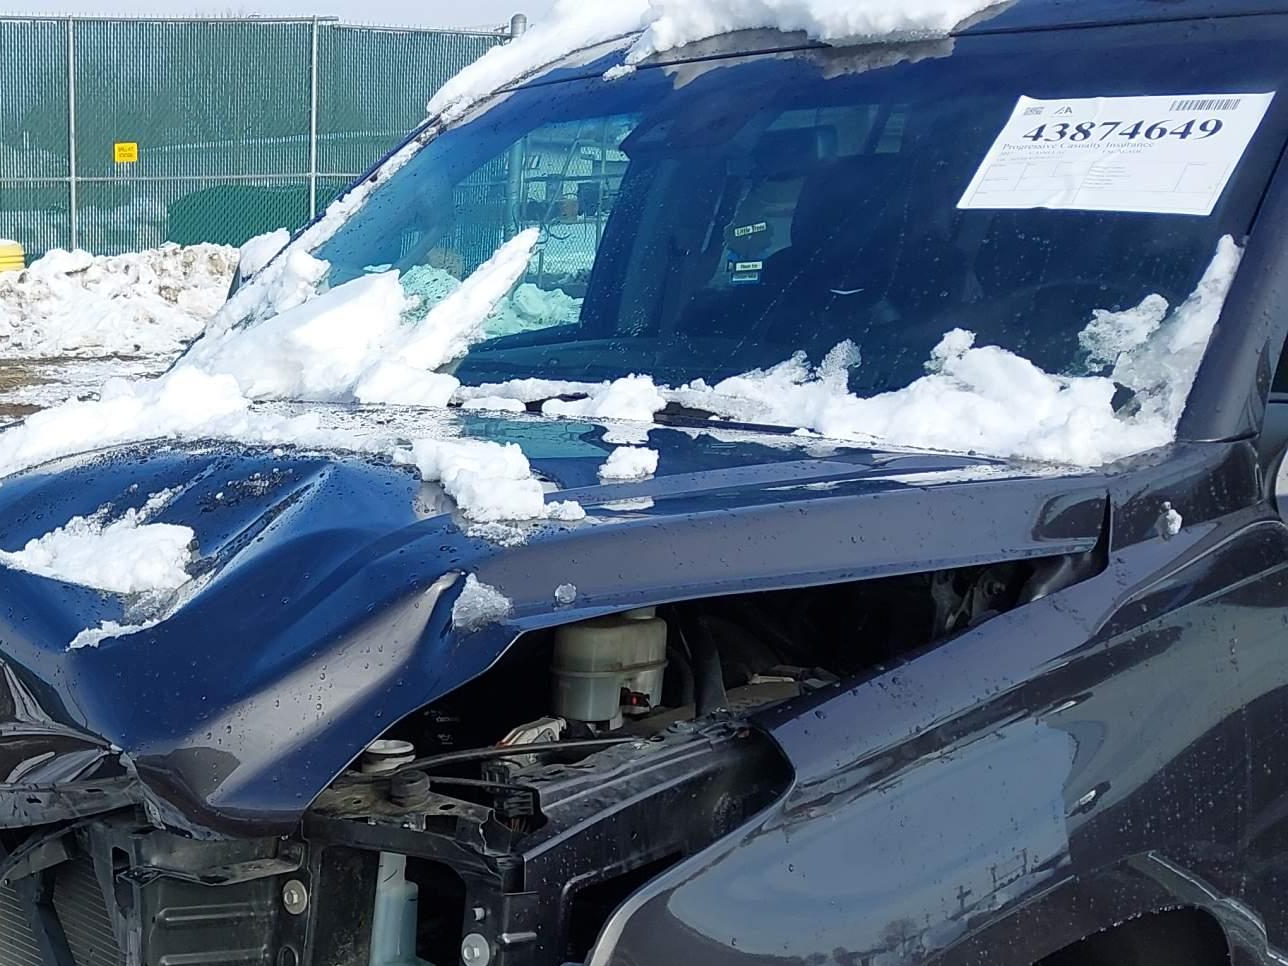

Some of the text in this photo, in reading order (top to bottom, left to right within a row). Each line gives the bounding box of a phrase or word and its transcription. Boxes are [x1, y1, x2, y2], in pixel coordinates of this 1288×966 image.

[1022, 118, 1224, 142] 43874649
[1003, 143, 1057, 152] Progressive
[1106, 141, 1155, 149] Insurance
